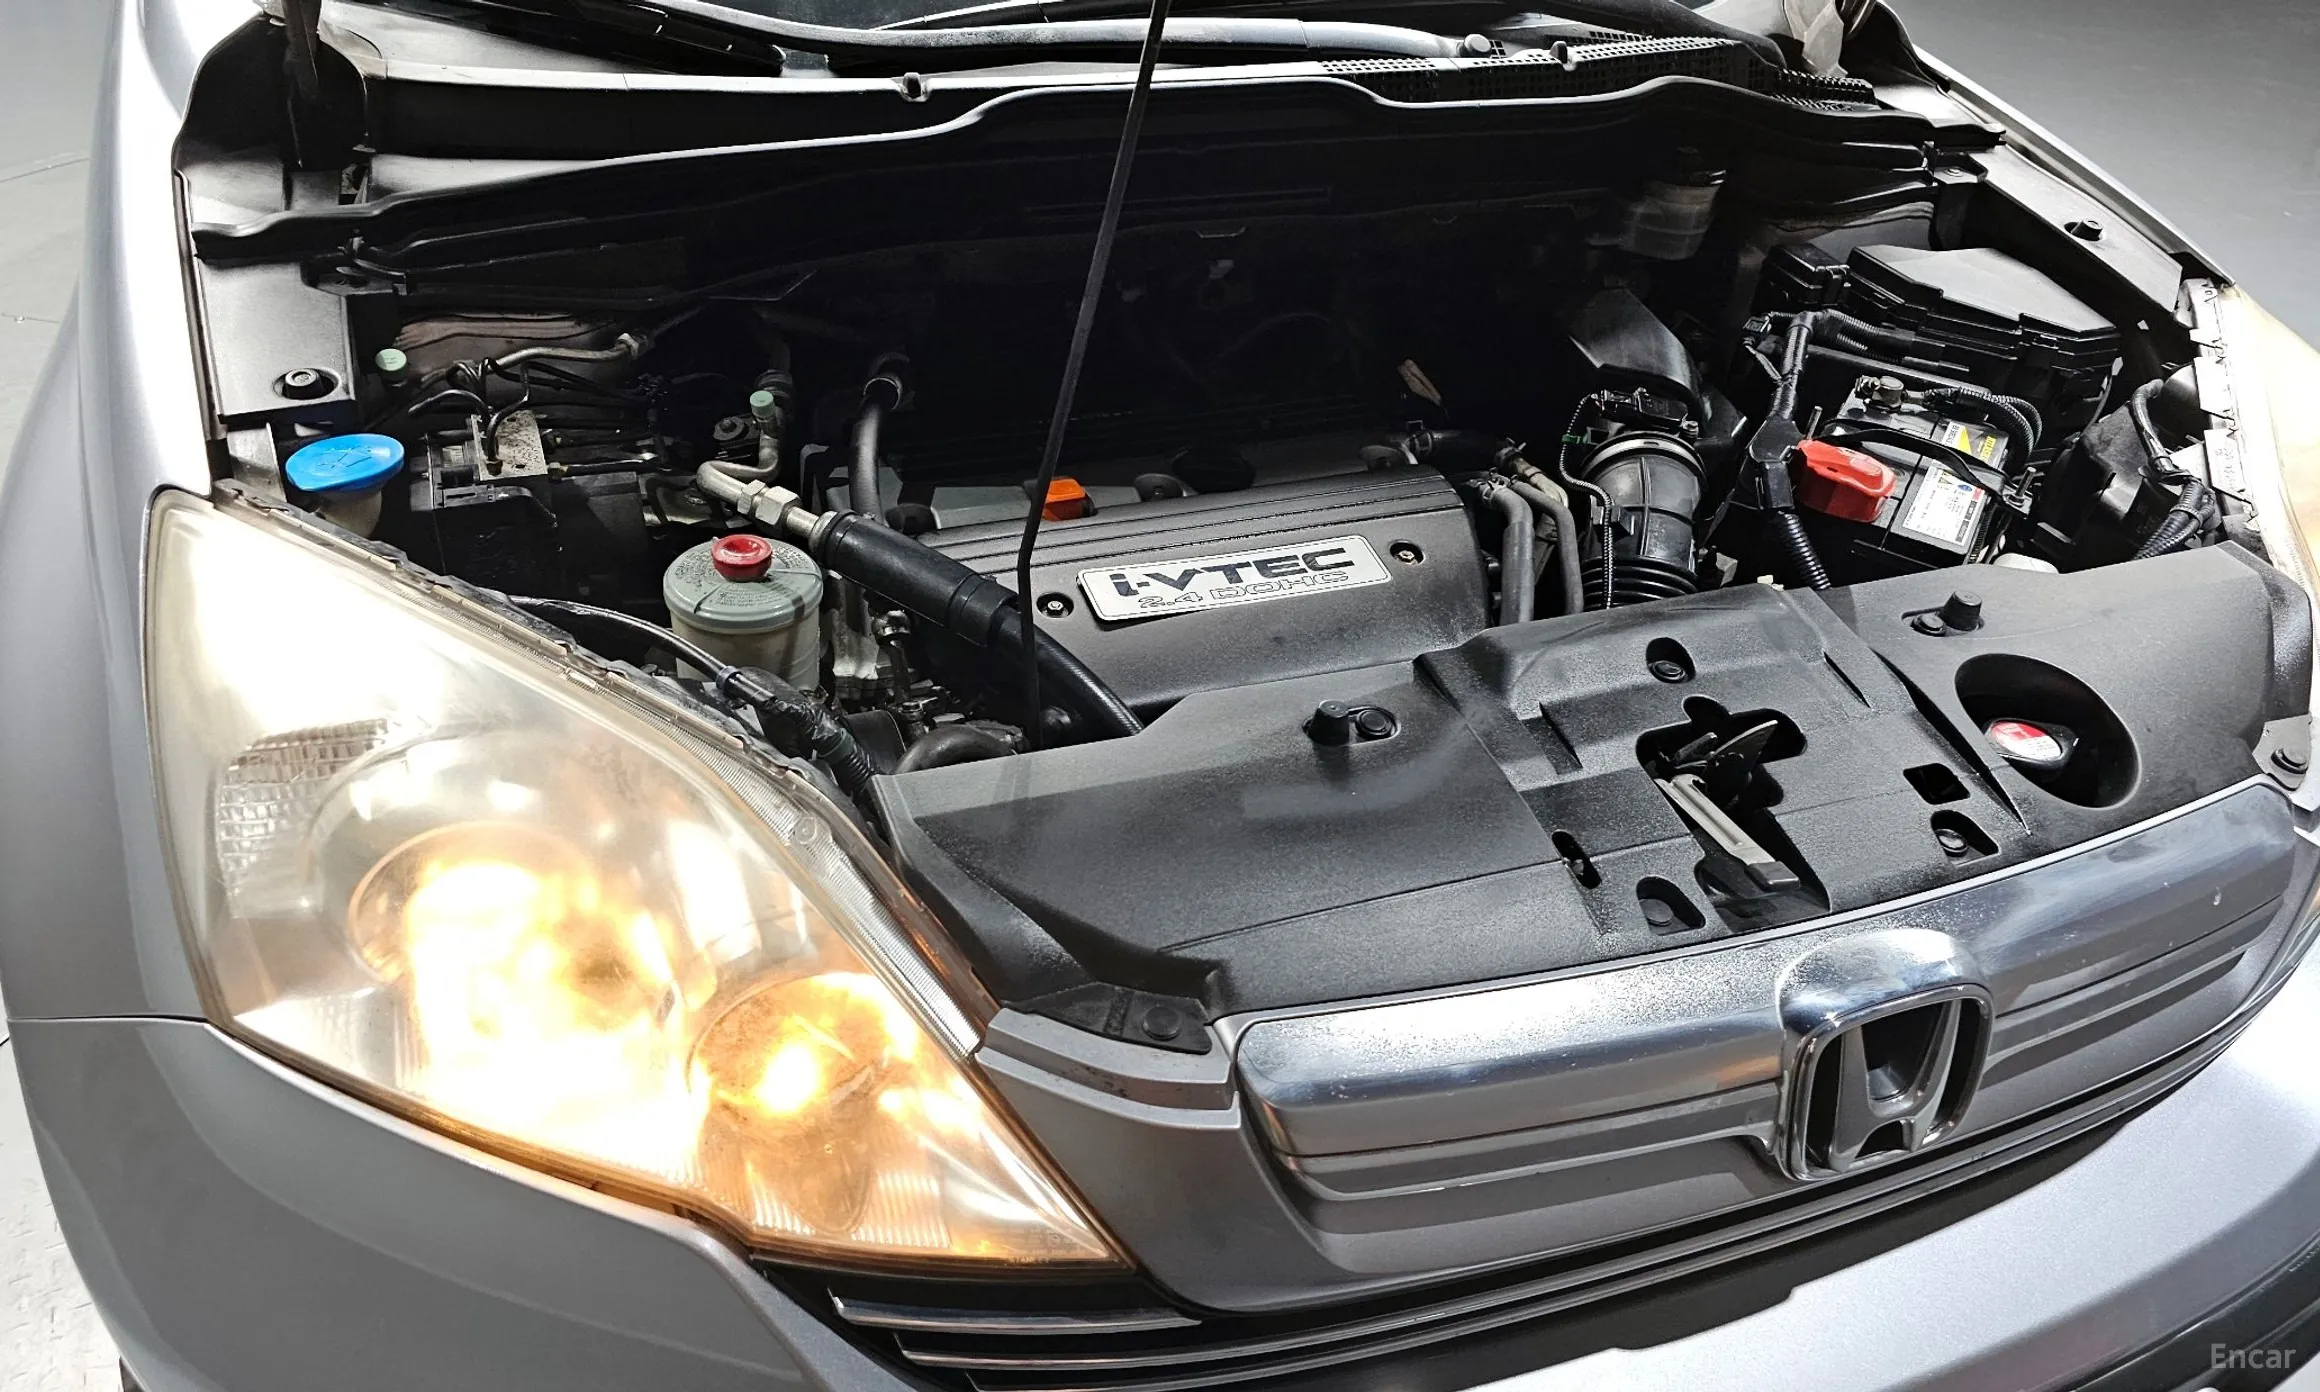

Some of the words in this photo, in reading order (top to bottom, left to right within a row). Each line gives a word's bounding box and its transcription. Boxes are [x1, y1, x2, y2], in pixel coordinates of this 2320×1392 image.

[1109, 547, 1354, 597] i-VTEC
[1138, 591, 1203, 609] 2.4
[1209, 571, 1349, 600] DOHC
